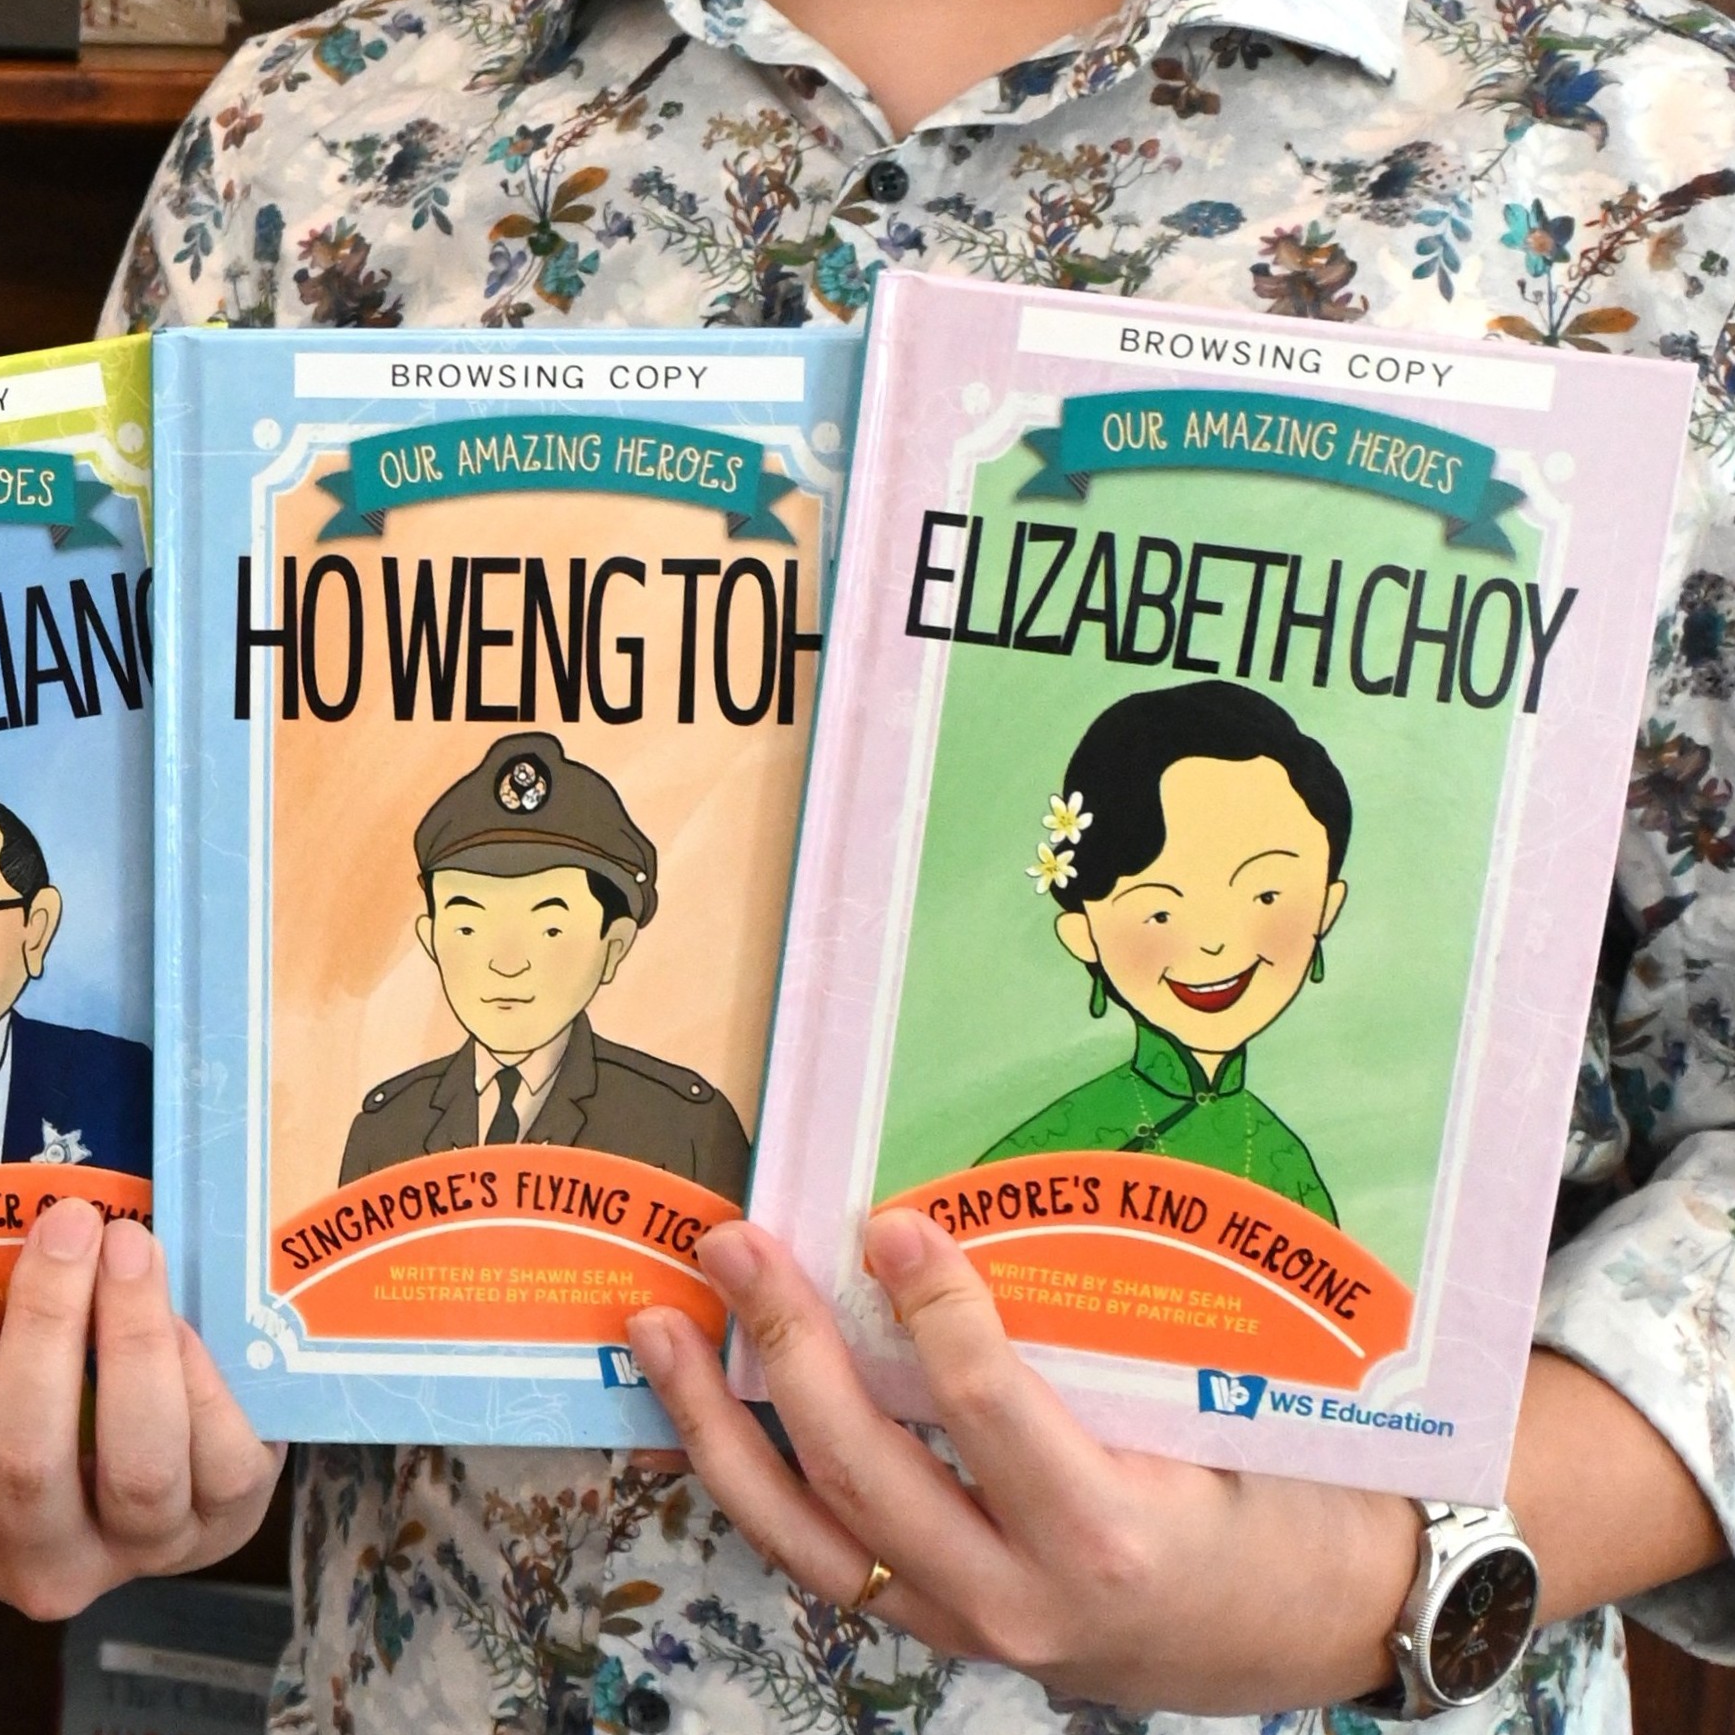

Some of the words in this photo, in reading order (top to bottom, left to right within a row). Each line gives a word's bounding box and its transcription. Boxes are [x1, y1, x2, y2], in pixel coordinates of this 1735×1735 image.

[390, 363, 585, 391] BROWSING
[608, 365, 710, 391] COPY
[1118, 326, 1324, 376] BROWSING
[1346, 352, 1455, 389] COPY
[379, 446, 444, 490] OUR
[457, 433, 602, 475] AMAZING
[614, 437, 744, 494] HEROES
[1101, 411, 1168, 453] OUR
[1182, 409, 1338, 461] AMAZING
[1346, 429, 1463, 495] HEROES
[233, 553, 364, 721] HO
[381, 555, 647, 725] WENG
[903, 508, 1344, 690] ELIZABETH
[1349, 562, 1580, 716] CHOY
[280, 1170, 499, 1271] SINGAPORE'S
[515, 1170, 630, 1226] FLYING
[642, 1200, 712, 1262] TIG
[918, 1175, 1101, 1235] GAPORE'S
[1119, 1179, 1209, 1234] KIND
[1218, 1210, 1374, 1322] HEROINE
[373, 1284, 502, 1304] ILLUSTRATED
[506, 1286, 532, 1304] BY
[534, 1286, 614, 1306] PATRICK
[617, 1289, 654, 1307] YEE
[389, 1265, 475, 1283] WRITTEN
[480, 1266, 506, 1284] BY
[508, 1267, 577, 1286] SHAWN
[581, 1268, 634, 1287] SEAH
[989, 1260, 1079, 1290] WRITTEN
[1082, 1268, 1107, 1293] BY
[1110, 1274, 1183, 1302] SHAWN
[1186, 1287, 1243, 1313] SEAH
[1105, 1298, 1132, 1317] BY
[1133, 1302, 1219, 1331] PATRICK
[1222, 1316, 1260, 1336] YEE
[1270, 1390, 1314, 1417] WS
[1321, 1398, 1455, 1438] Education
